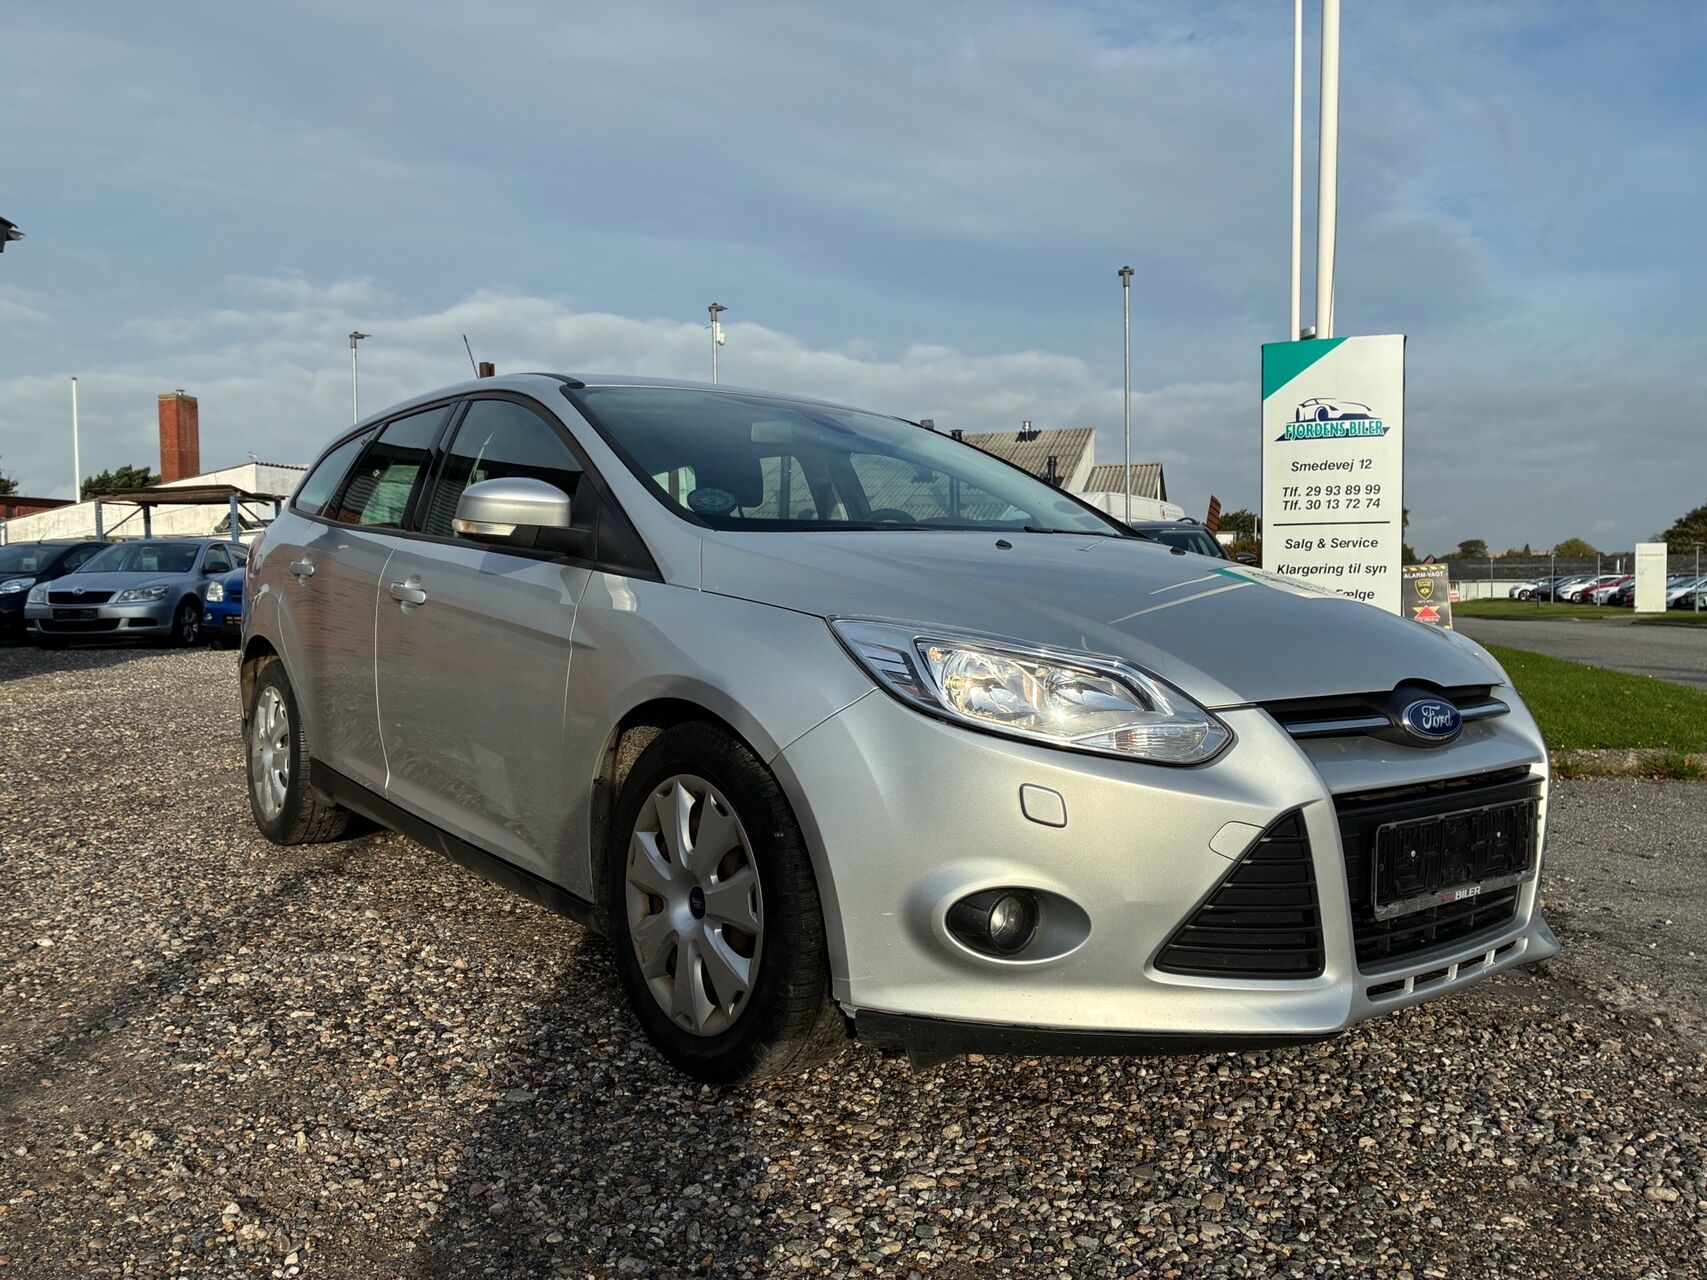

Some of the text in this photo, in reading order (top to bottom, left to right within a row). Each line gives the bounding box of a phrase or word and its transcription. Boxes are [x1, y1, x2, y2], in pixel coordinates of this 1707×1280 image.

[1285, 420, 1384, 439] FJORDENS BILER
[1291, 459, 1372, 472] Smedevej 12
[1282, 484, 1381, 497] Tlf. 29 93 89 99
[1282, 498, 1381, 510] Tlf. 30 13 72 74
[1285, 537, 1378, 551] Salg & Service
[1277, 563, 1387, 577] Klargøring til syn
[1421, 705, 1454, 729] Ford
